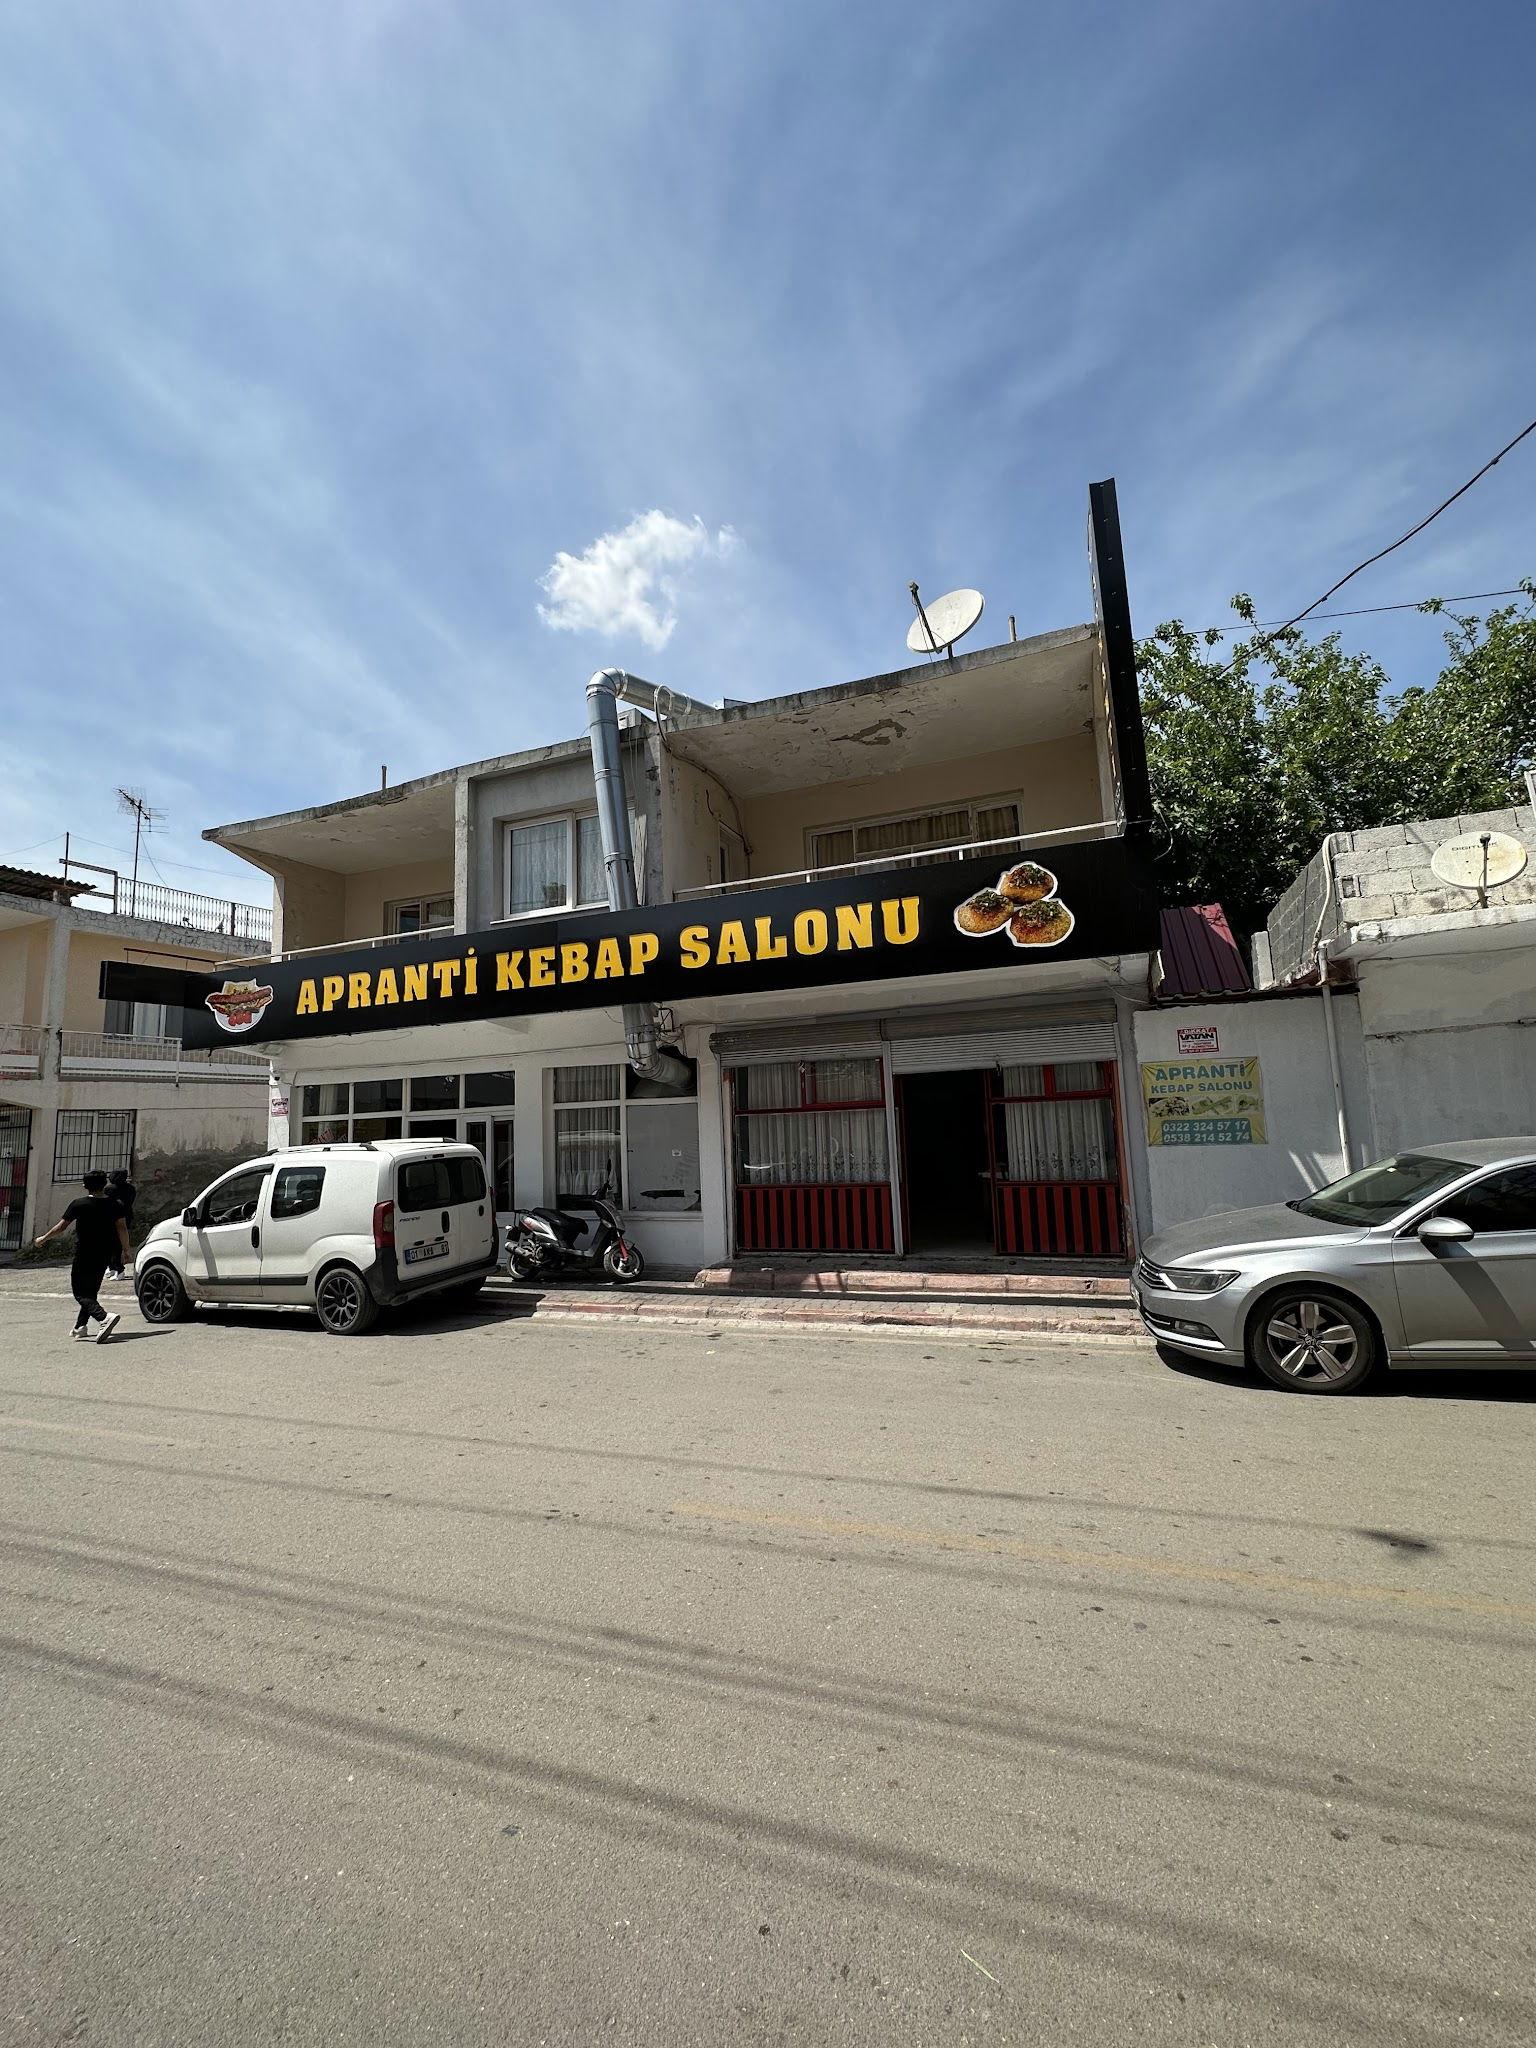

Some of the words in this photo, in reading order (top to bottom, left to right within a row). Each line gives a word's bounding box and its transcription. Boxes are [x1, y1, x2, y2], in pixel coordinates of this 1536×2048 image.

[1452, 842, 1497, 851] DIGITUK
[296, 947, 479, 1015] APRANTİ
[495, 932, 660, 992] KEBAP
[679, 895, 920, 969] SALONU
[1155, 1061, 1245, 1081] APRANTİ
[1151, 1083, 1194, 1094] KEBAP
[1198, 1080, 1253, 1092] SALONU
[1163, 1122, 1190, 1132] 0322
[1193, 1122, 1214, 1131] 324
[1217, 1121, 1231, 1130] 57
[1235, 1120, 1249, 1130] 17
[1164, 1133, 1191, 1142] 0538
[1194, 1133, 1215, 1142] 214
[1218, 1132, 1232, 1141] 52
[1236, 1131, 1250, 1141] 74
[411, 1250, 418, 1260] 01
